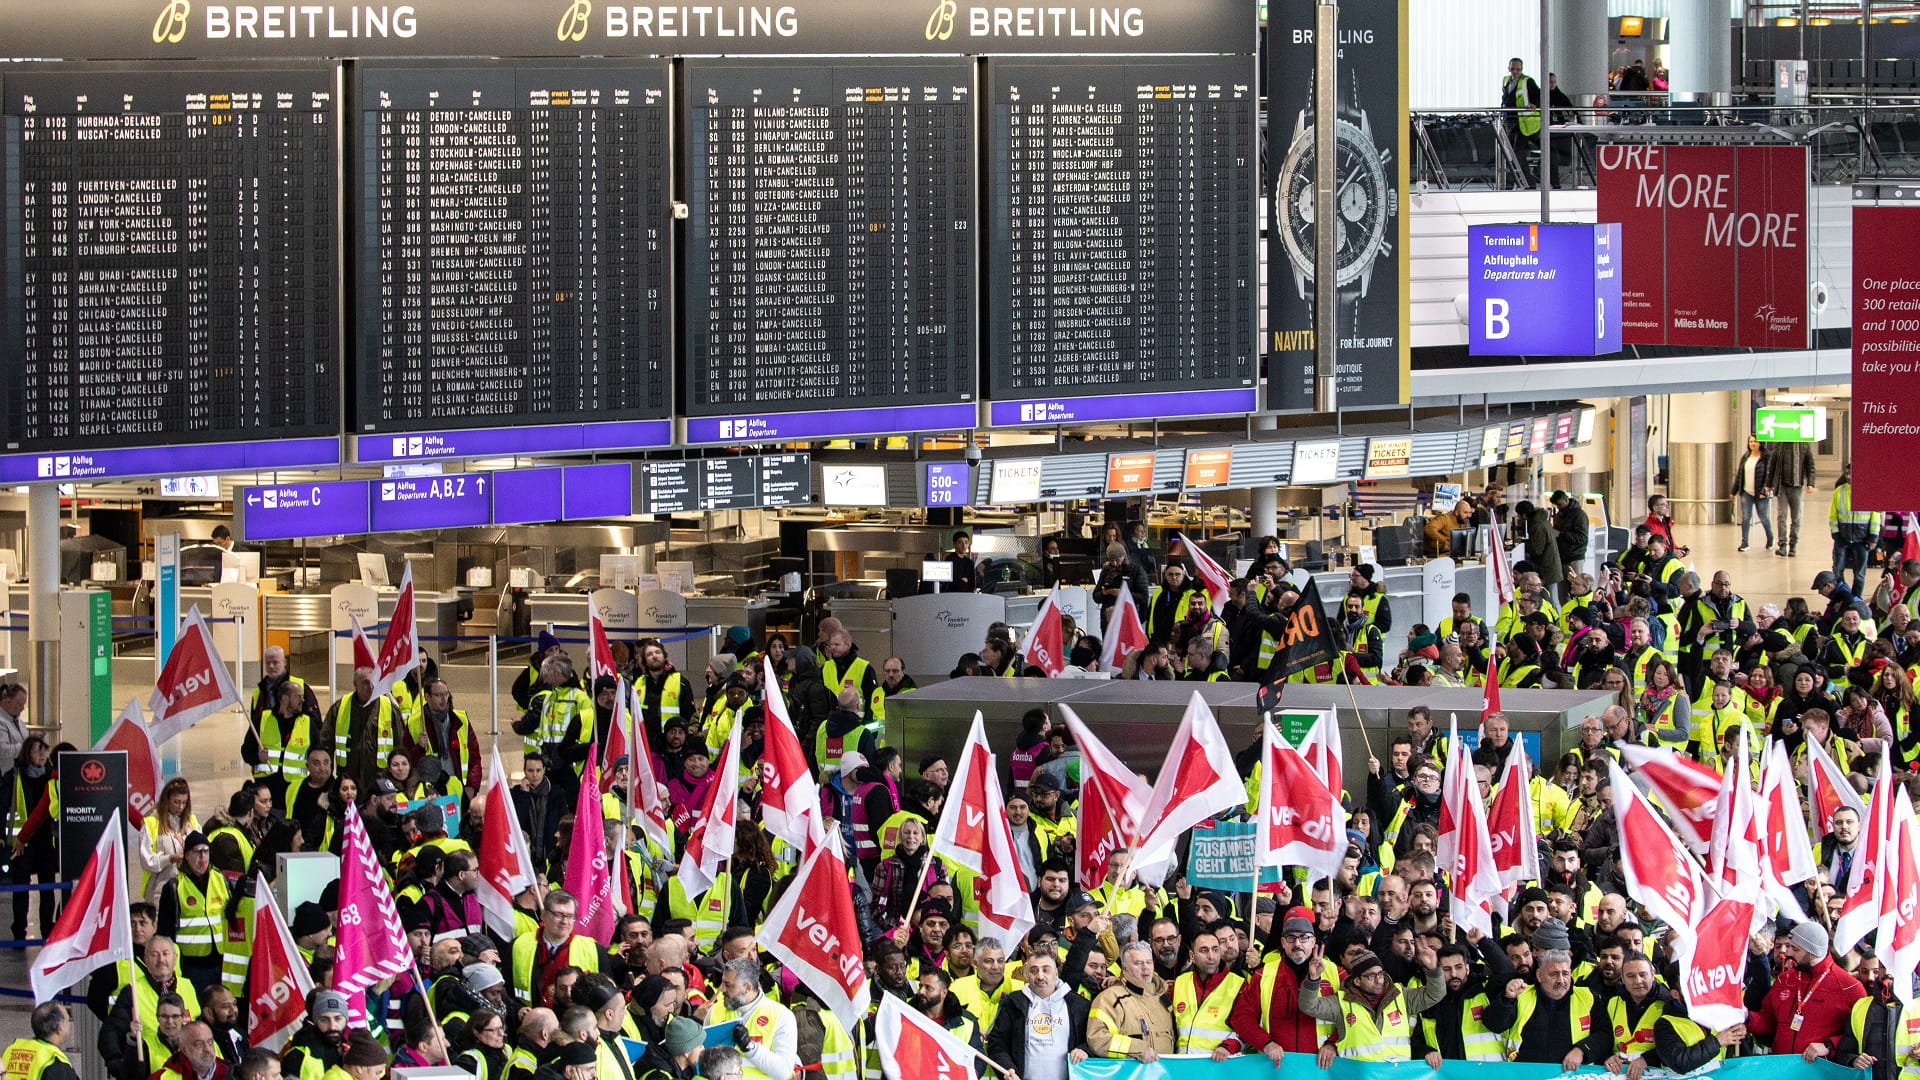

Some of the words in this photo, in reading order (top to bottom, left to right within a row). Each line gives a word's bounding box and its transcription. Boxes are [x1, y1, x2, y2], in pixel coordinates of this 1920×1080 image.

[206, 6, 417, 38] BREITLING
[606, 7, 798, 37] BREITLING
[969, 8, 1144, 36] BREITLING
[1292, 29, 1374, 44] BRLING
[381, 111, 391, 122] LH
[406, 111, 420, 122] 442
[1011, 138, 1019, 147] LH
[1028, 138, 1044, 147] 1204
[709, 155, 717, 165] DE
[727, 154, 745, 165] 3910
[754, 154, 763, 164] LA
[1052, 160, 1097, 170] DUESSELDORF
[1101, 160, 1113, 169] HBF
[381, 173, 391, 184] LH
[406, 173, 420, 183] 890
[1635, 173, 1730, 208] MORE
[24, 195, 35, 205] BA
[51, 194, 67, 204] 903
[1011, 207, 1020, 216] EN
[1028, 206, 1044, 216] 8042
[954, 221, 968, 231] E23
[1704, 212, 1800, 248] MORE
[1484, 235, 1524, 246] Terminal
[1530, 236, 1536, 246] 1
[1484, 255, 1538, 268] Abflughalle
[78, 271, 94, 281] ABU
[1483, 269, 1535, 281] Departures
[1537, 269, 1556, 280] hall
[1862, 278, 1888, 290] One
[1862, 298, 1885, 311] 300
[431, 307, 483, 318] DUESSELDORF
[488, 307, 502, 316] HBF
[1597, 297, 1605, 339] B
[1485, 298, 1510, 339] B
[1674, 318, 1697, 328] Miles
[1698, 318, 1705, 329] &
[1706, 319, 1728, 329] More
[1770, 315, 1798, 324] Frankfurt
[1769, 324, 1791, 333] Airport
[1862, 319, 1886, 331] and
[1890, 319, 1920, 331] 1000
[711, 333, 719, 343] IB
[728, 332, 745, 342] 8707
[1340, 339, 1352, 349] FOR
[1365, 337, 1393, 348] JOURNEY
[382, 347, 392, 357] NH
[407, 346, 421, 356] 204
[315, 363, 325, 373] T5
[1862, 360, 1887, 373] take
[1889, 363, 1912, 376] you
[1047, 402, 1065, 412] Abflug
[1862, 401, 1886, 414] This
[1888, 402, 1898, 414] is
[1047, 410, 1075, 420] Departures
[748, 418, 767, 429] Abflug
[748, 427, 778, 437] Departures
[424, 435, 444, 447] Abflug
[424, 444, 456, 455] Departures
[1299, 447, 1337, 459] TICKETS
[1373, 448, 1407, 458] TICKETS
[72, 455, 93, 467] Abflug
[72, 464, 106, 476] Departures
[998, 466, 1039, 478] TICKETS
[397, 481, 416, 491] Abflug
[279, 489, 298, 499] Abflug
[311, 486, 321, 506] C
[397, 490, 428, 500] Departures
[931, 490, 952, 503] 570
[279, 497, 309, 508] Departures
[66, 806, 96, 815] PRIORITY
[66, 815, 103, 823] PRIORITAIRE
[1195, 858, 1227, 873] GEHT
[1229, 856, 1256, 873] MEH
[796, 905, 864, 987] ver.di
